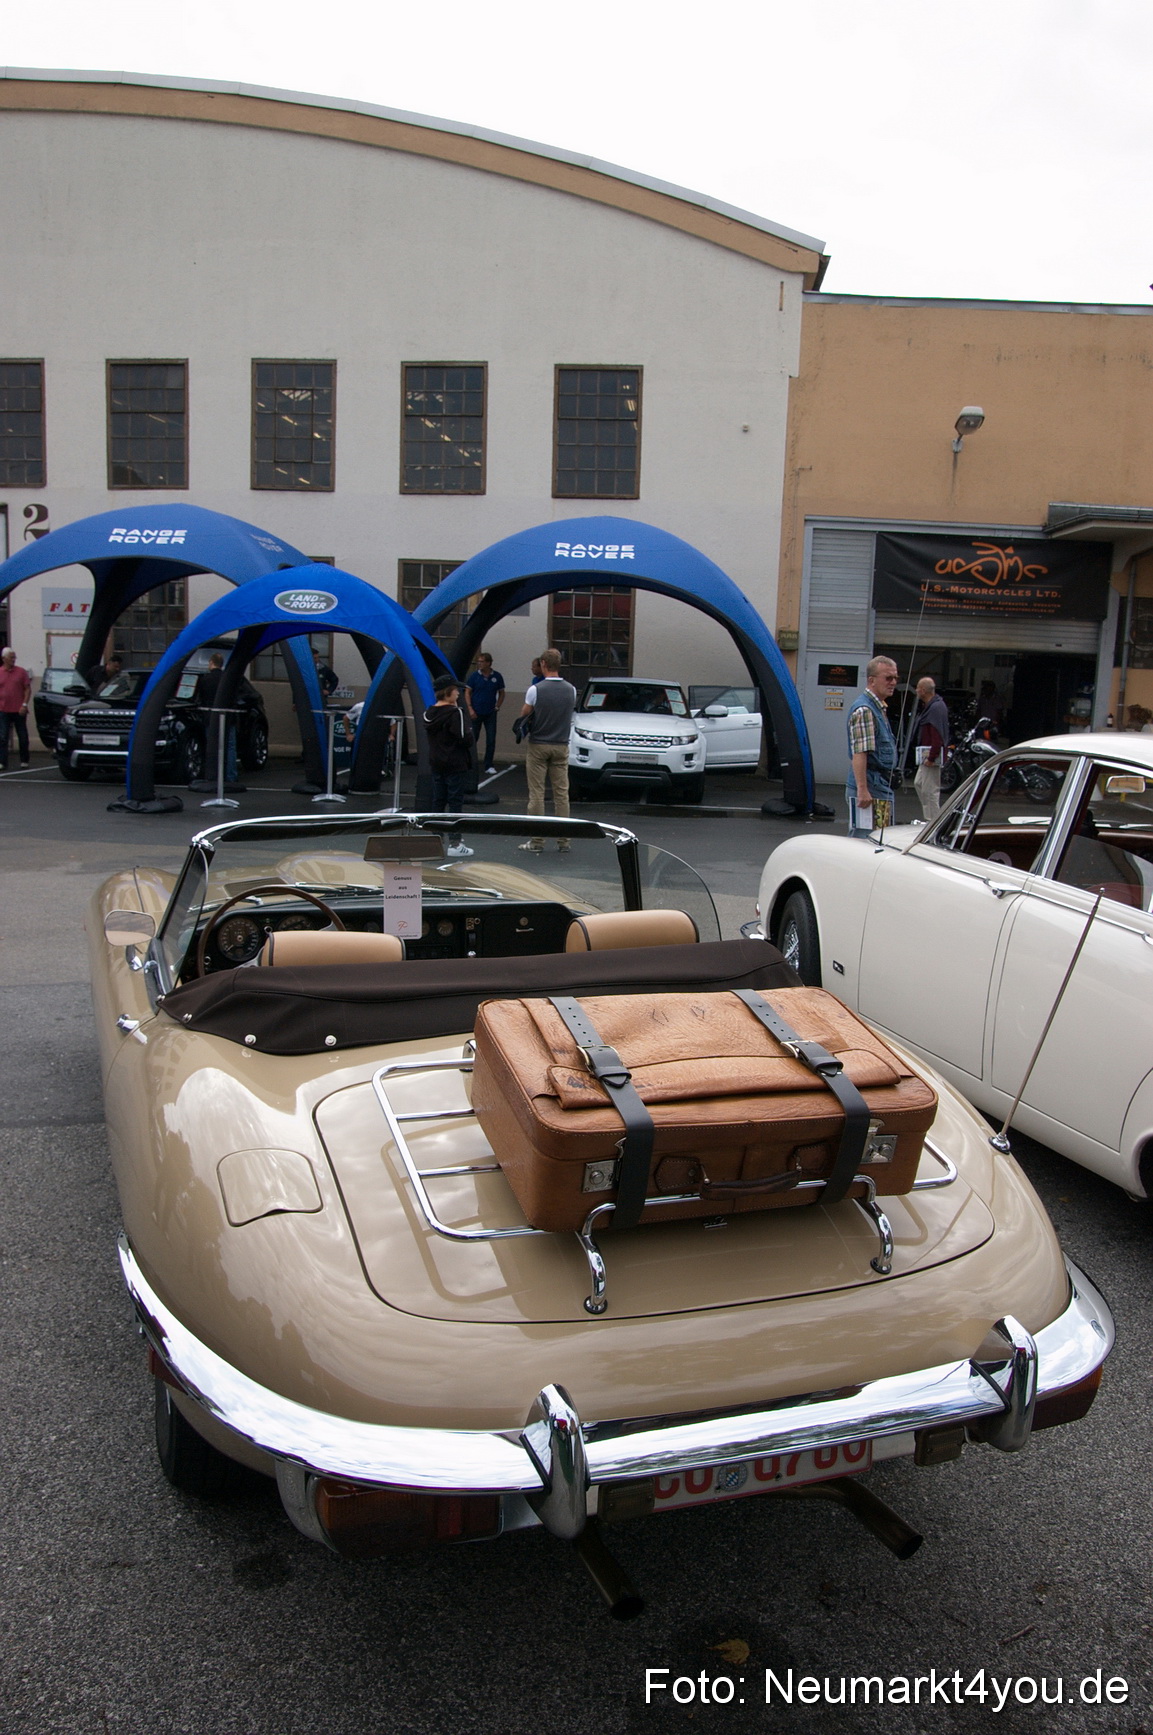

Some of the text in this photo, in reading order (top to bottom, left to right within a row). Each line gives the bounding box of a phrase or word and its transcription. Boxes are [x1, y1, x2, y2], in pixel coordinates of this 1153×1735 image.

[23, 503, 50, 541] 2
[112, 528, 188, 536] RANGE
[108, 535, 185, 544] ROVER
[556, 542, 635, 551] RANGE
[555, 550, 635, 559] ROVER
[289, 594, 318, 602] LAND
[290, 601, 327, 609] ROVER
